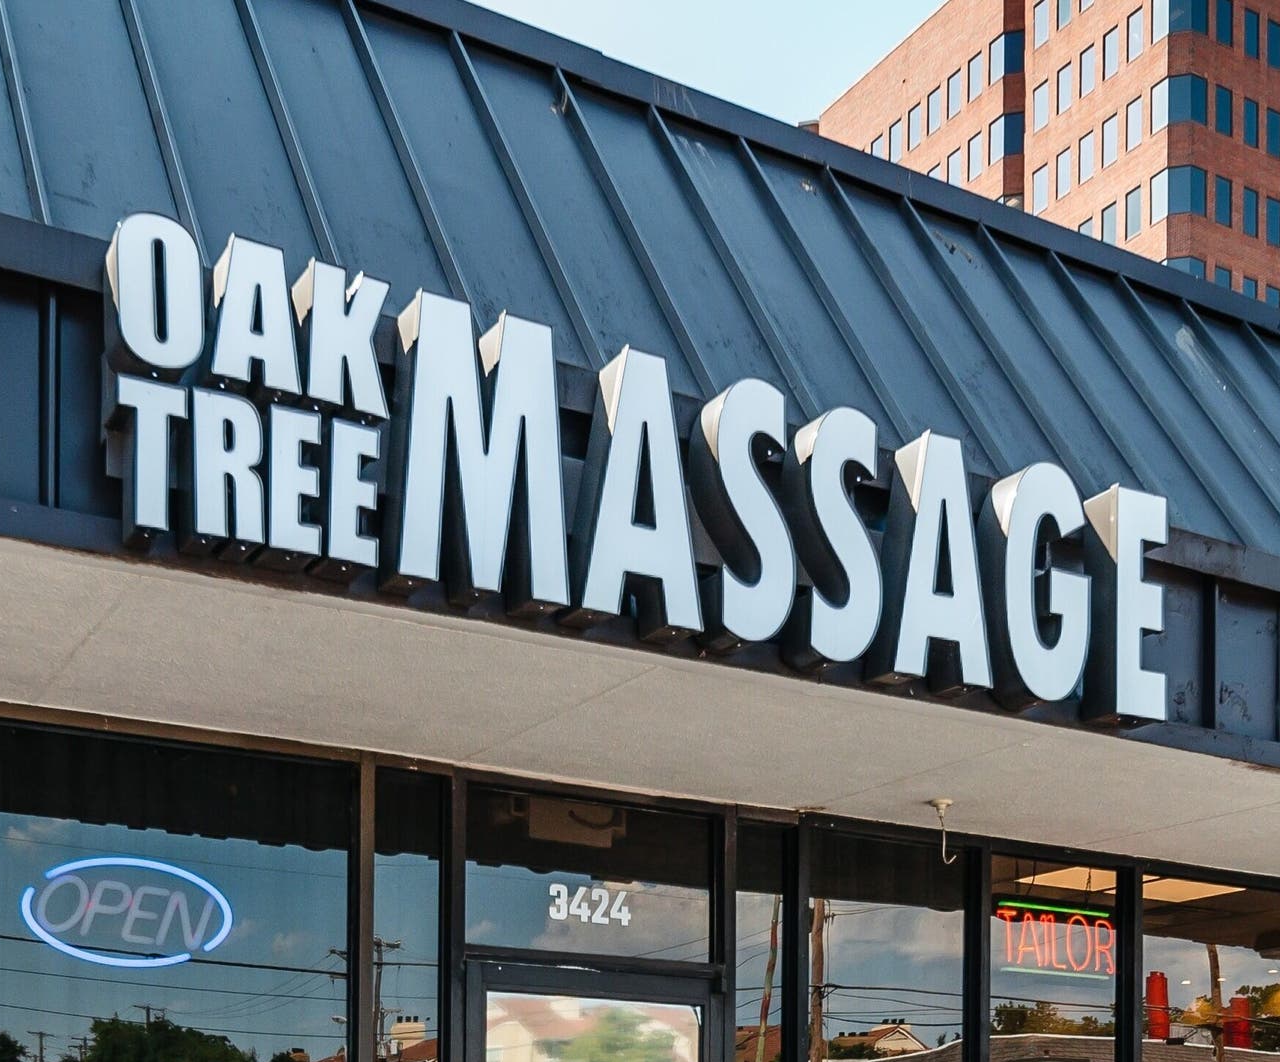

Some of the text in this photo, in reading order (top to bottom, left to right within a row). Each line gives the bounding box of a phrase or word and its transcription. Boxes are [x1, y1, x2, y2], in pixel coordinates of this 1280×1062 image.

[113, 212, 389, 419] OAK
[117, 374, 381, 569] TREE
[397, 287, 1169, 722] MASSAGE
[36, 874, 215, 950] OPEN
[549, 883, 631, 926] 3424
[997, 908, 1115, 974] TAILOR
